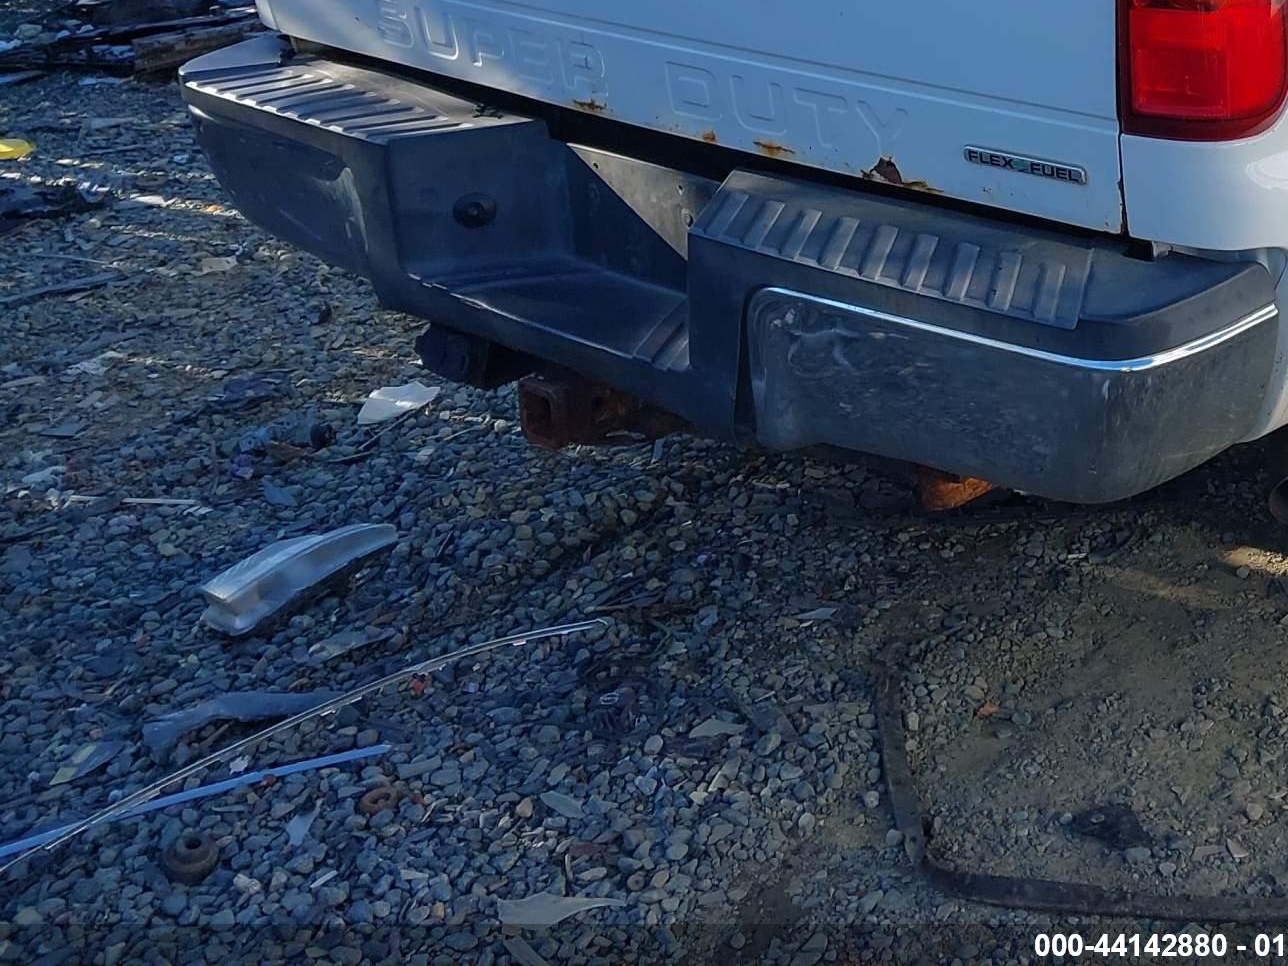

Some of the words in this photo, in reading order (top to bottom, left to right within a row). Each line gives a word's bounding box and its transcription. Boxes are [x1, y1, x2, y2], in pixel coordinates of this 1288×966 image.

[664, 60, 910, 158] DUTY
[967, 149, 1015, 171] FLEX
[1029, 161, 1081, 183] FUEL
